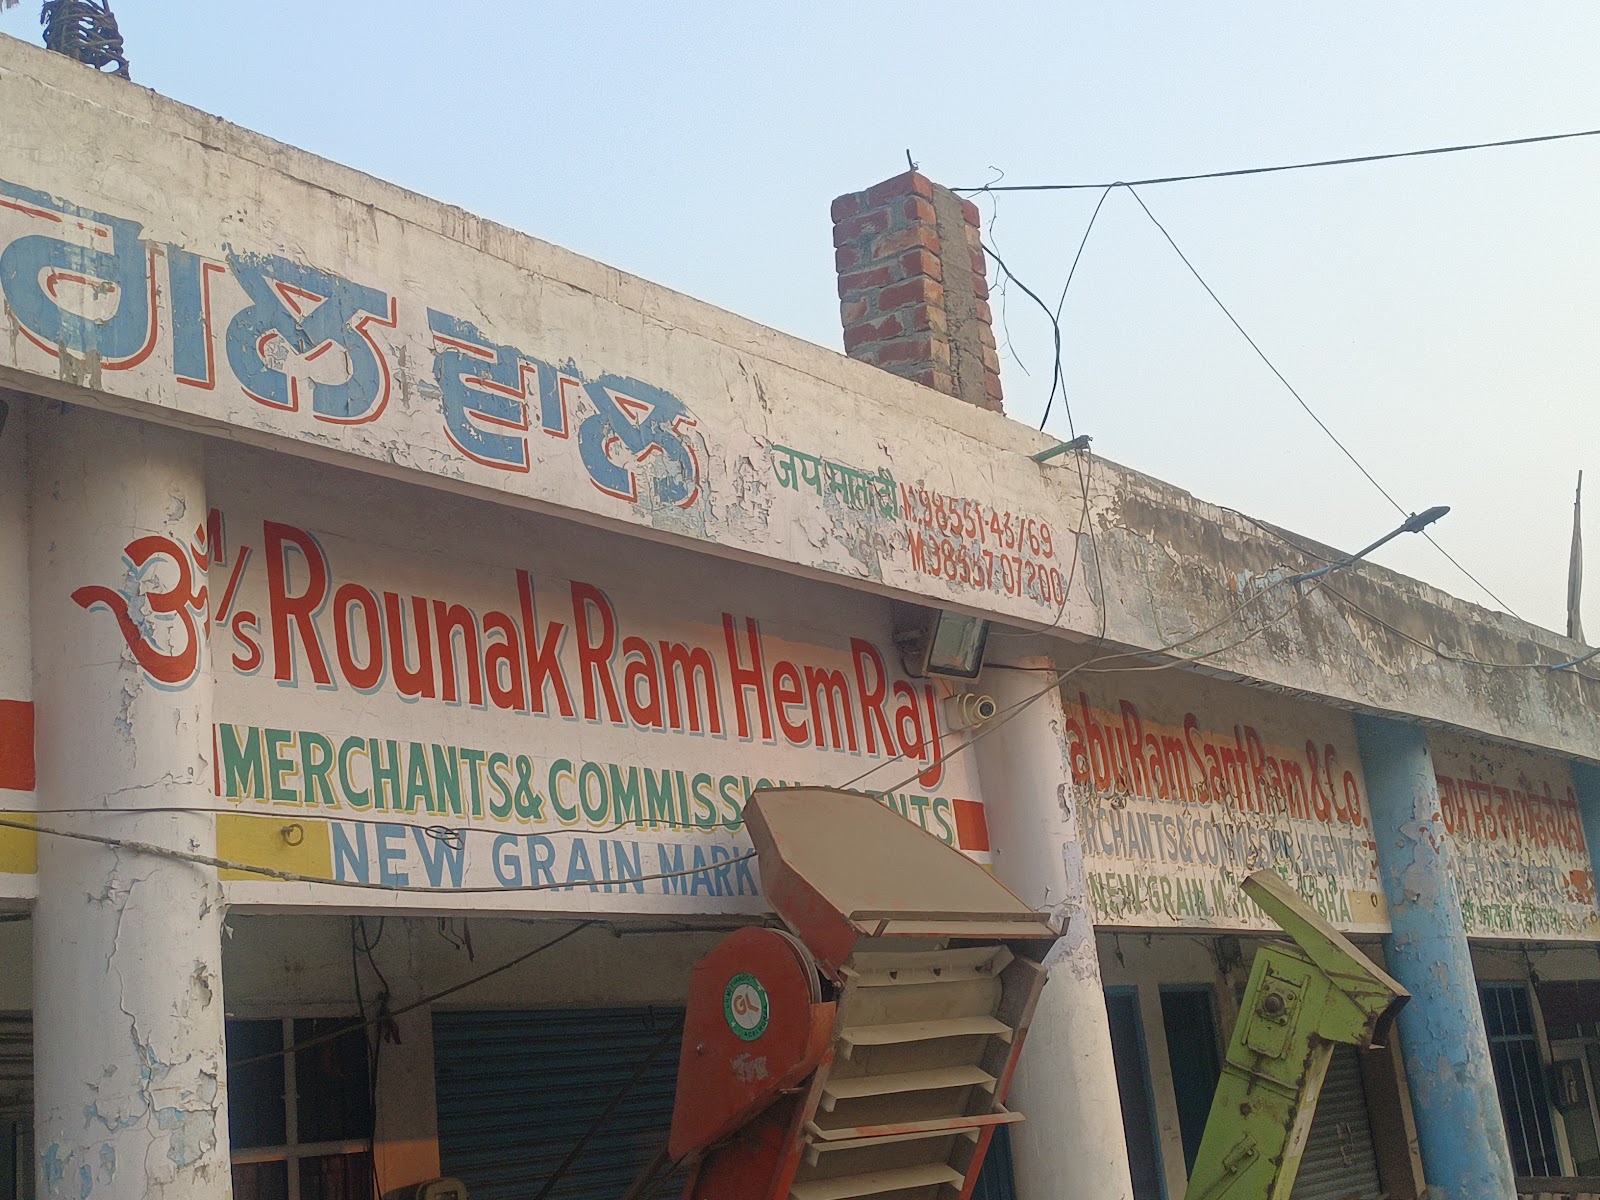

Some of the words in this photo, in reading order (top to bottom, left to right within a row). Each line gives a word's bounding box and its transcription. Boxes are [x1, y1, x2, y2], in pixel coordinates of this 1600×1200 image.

[262, 519, 573, 717] Rounak
[570, 579, 728, 739] Ram
[722, 612, 864, 755] Hem
[850, 636, 944, 789] Raj
[330, 821, 468, 889] NEW
[491, 833, 645, 896] GRAIN
